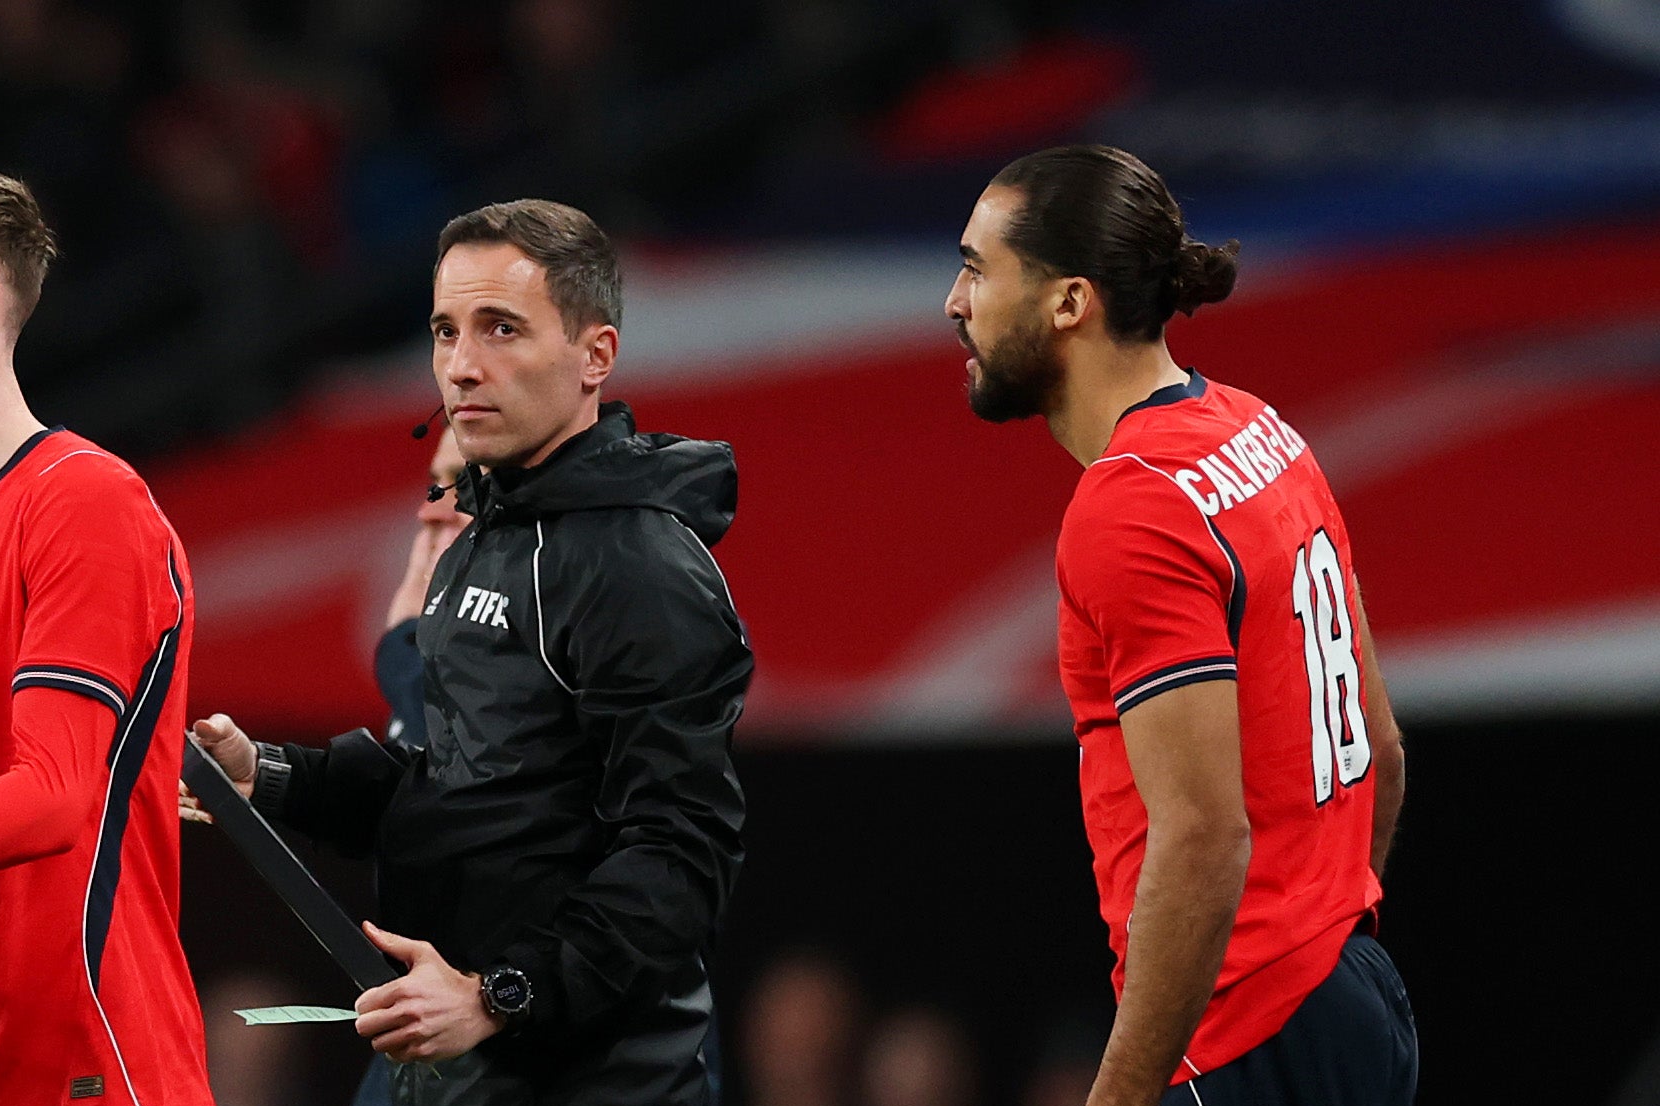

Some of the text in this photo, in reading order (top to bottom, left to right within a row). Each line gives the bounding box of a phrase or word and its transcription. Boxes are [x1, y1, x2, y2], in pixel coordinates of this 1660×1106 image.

[1174, 404, 1307, 517] CALVERT-LE
[457, 586, 509, 630] FIFA
[1291, 526, 1372, 806] 18
